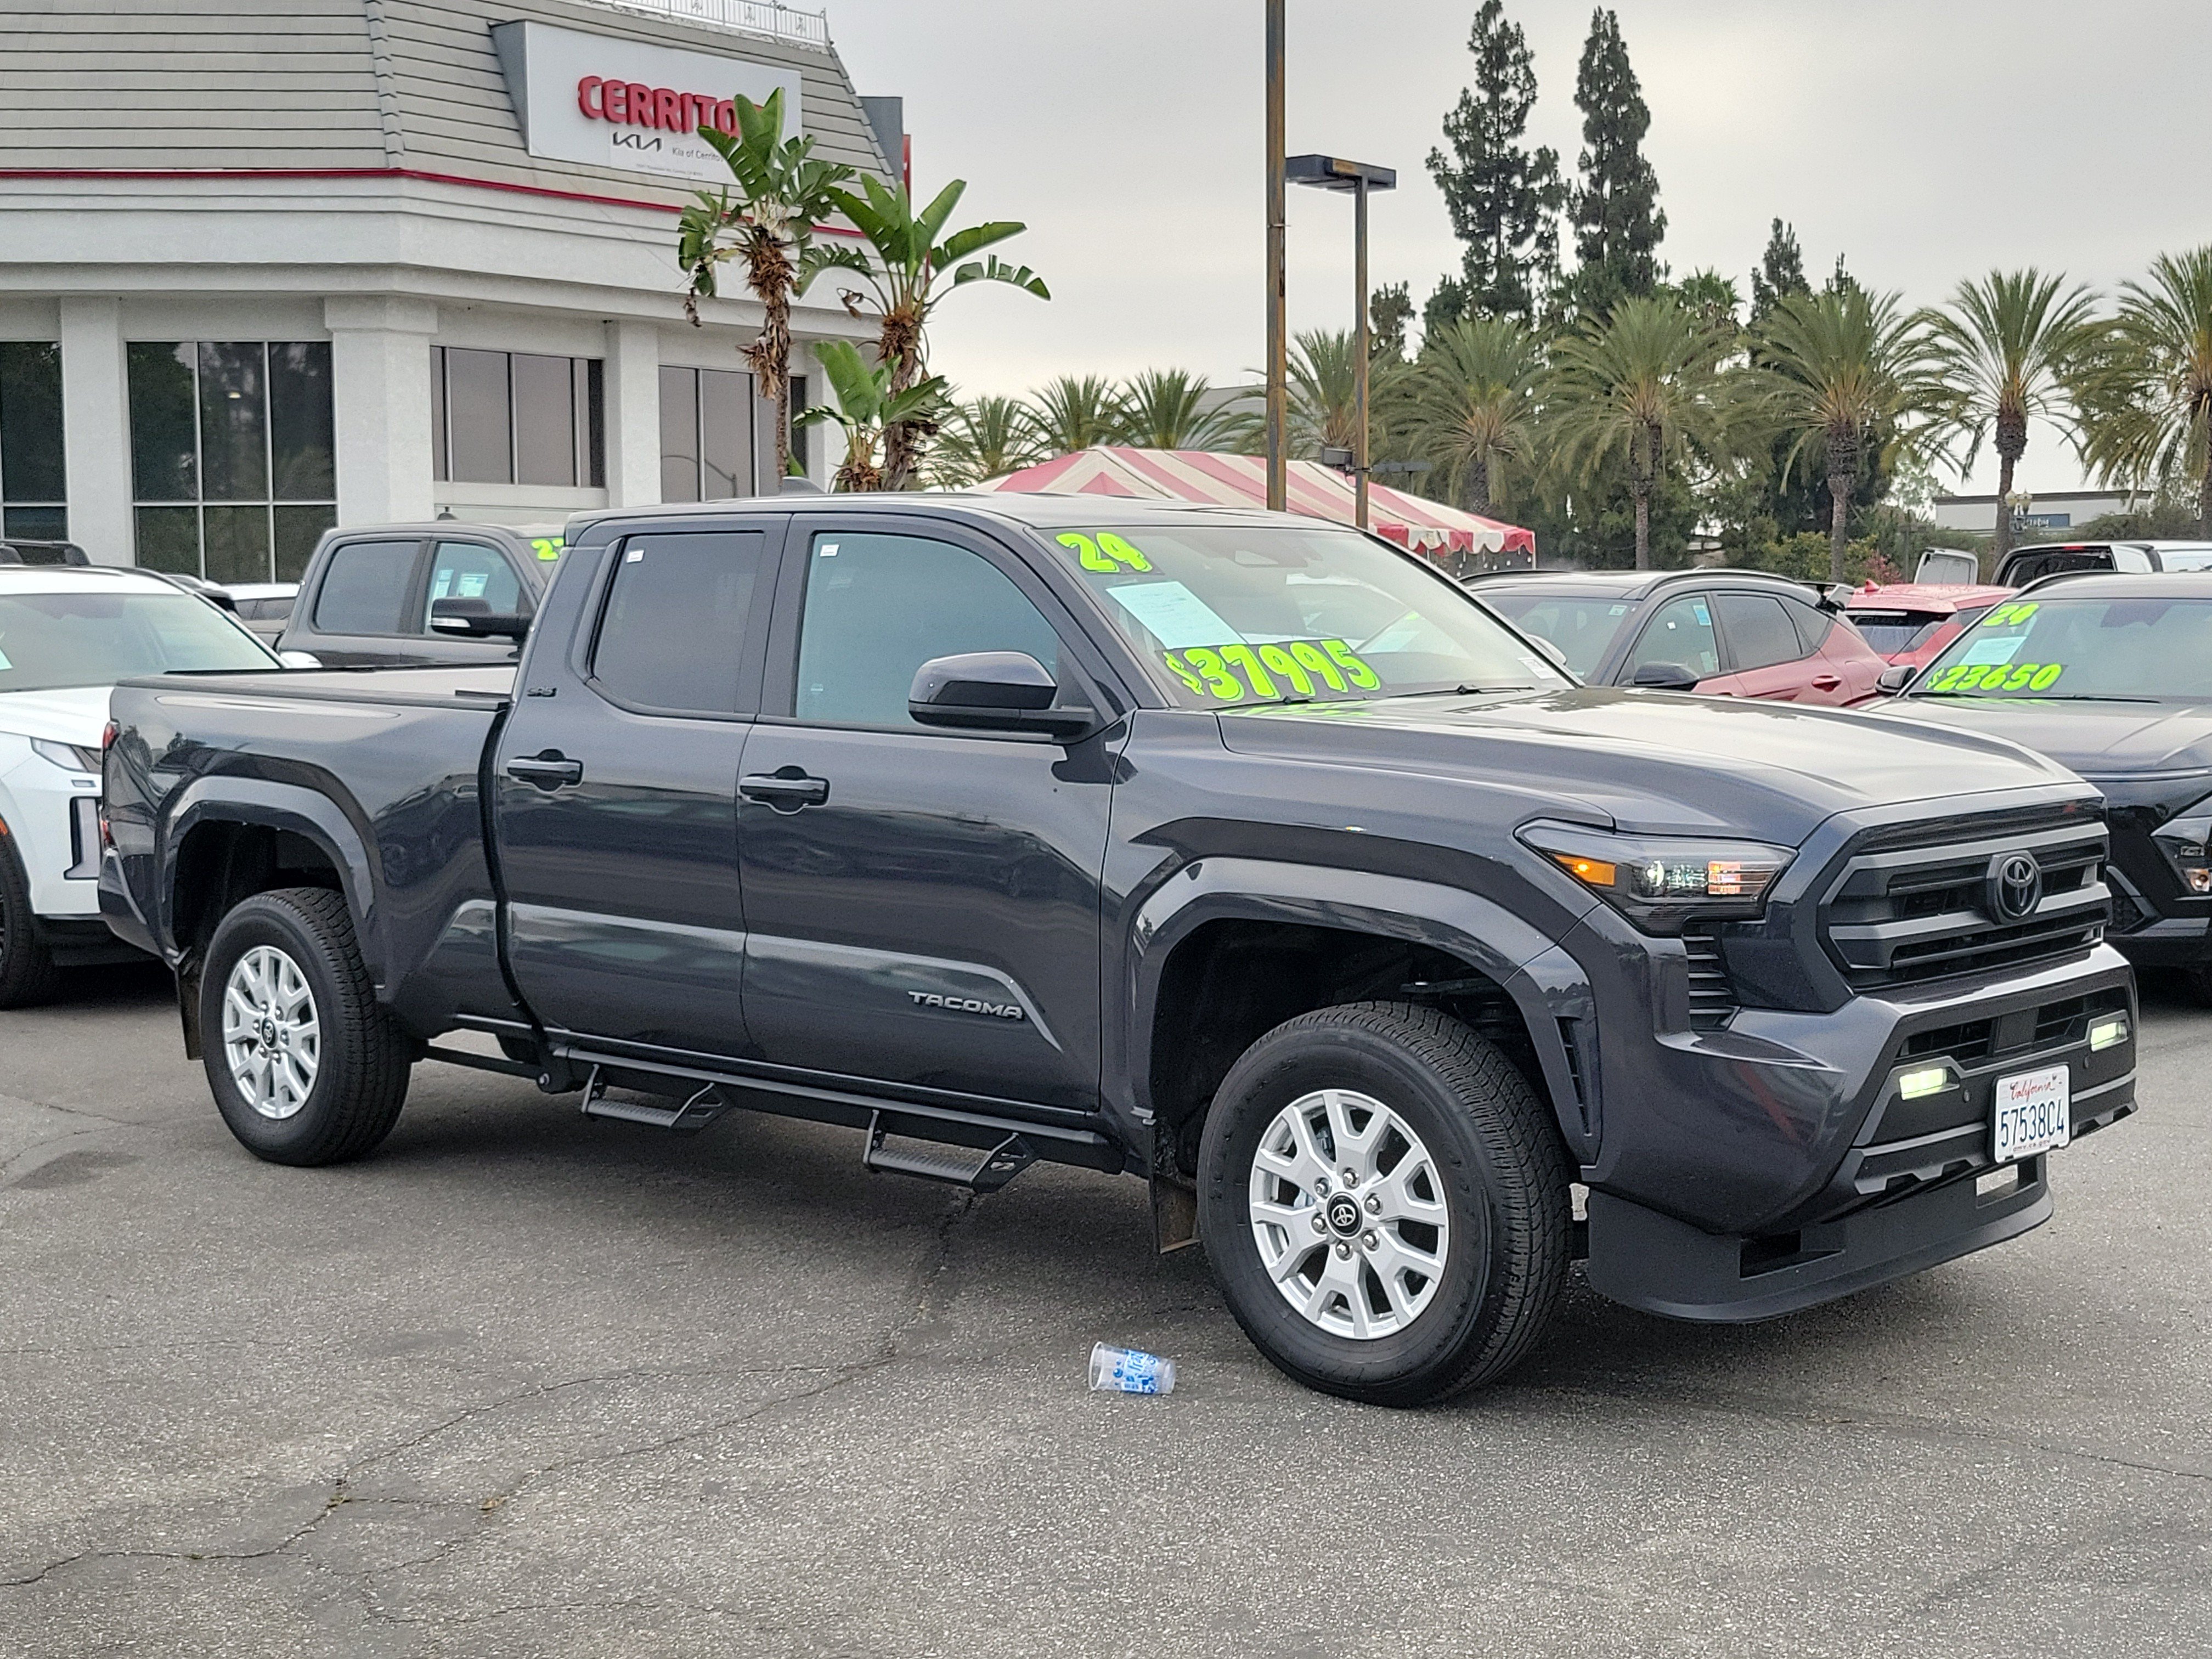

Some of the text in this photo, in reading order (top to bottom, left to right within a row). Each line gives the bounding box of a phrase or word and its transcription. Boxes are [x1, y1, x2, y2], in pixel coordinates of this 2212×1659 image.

[578, 76, 764, 138] CERRITO
[1056, 533, 1152, 573] 24
[1982, 603, 2039, 627] 24
[1164, 639, 1381, 701] $37995
[1926, 663, 2062, 691] $23650
[908, 991, 1024, 1020] TACOMA
[2010, 1078, 2056, 1102] California
[2001, 1099, 2064, 1147] 57538C4
